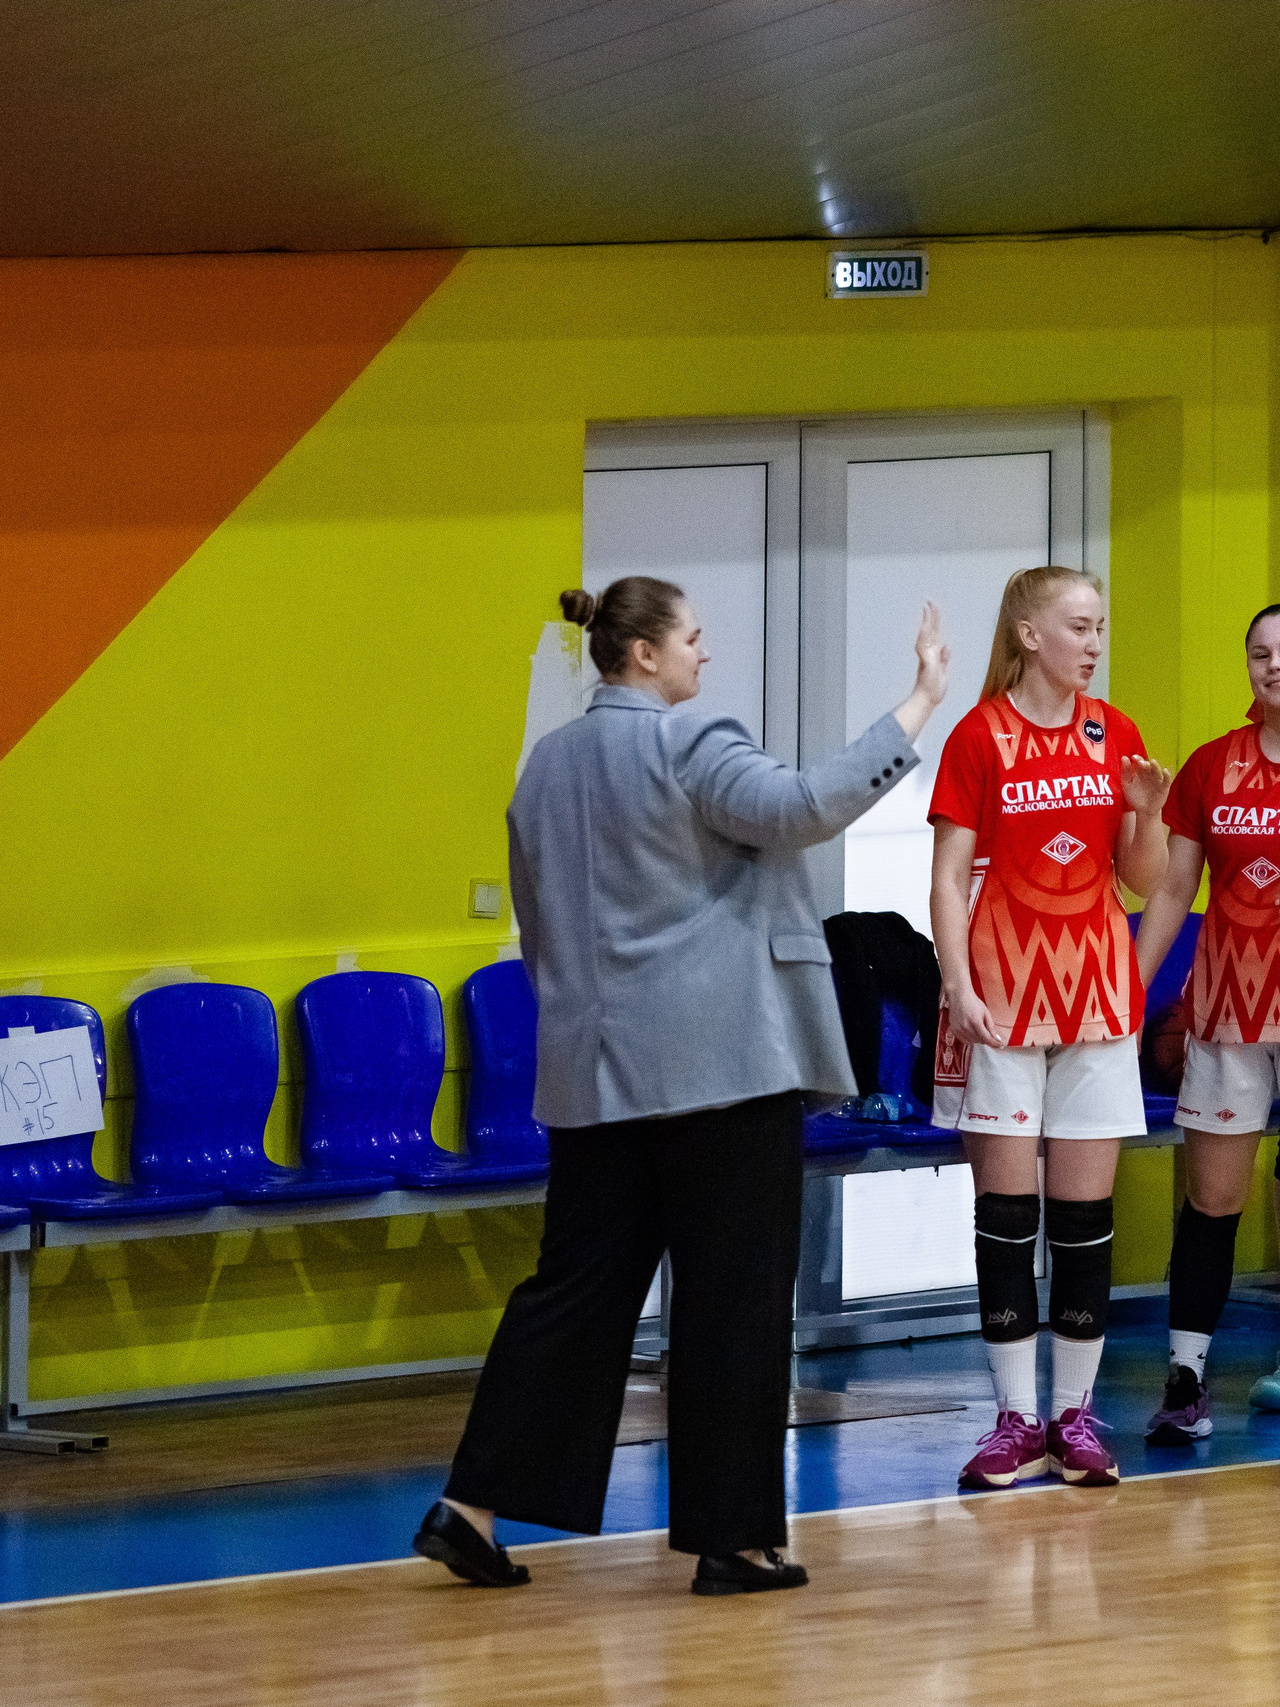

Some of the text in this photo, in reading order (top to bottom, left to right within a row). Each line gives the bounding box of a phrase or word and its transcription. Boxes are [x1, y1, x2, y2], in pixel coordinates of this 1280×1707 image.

[836, 261, 917, 288] ВЫХОД
[1001, 774, 1113, 804] СПАРТАК
[1002, 796, 1114, 814] МОСКОВСКАЯ ОБЛАСТЬ
[1211, 826, 1274, 835] МОСКОВСКАЯ
[23, 1102, 58, 1136] #15
